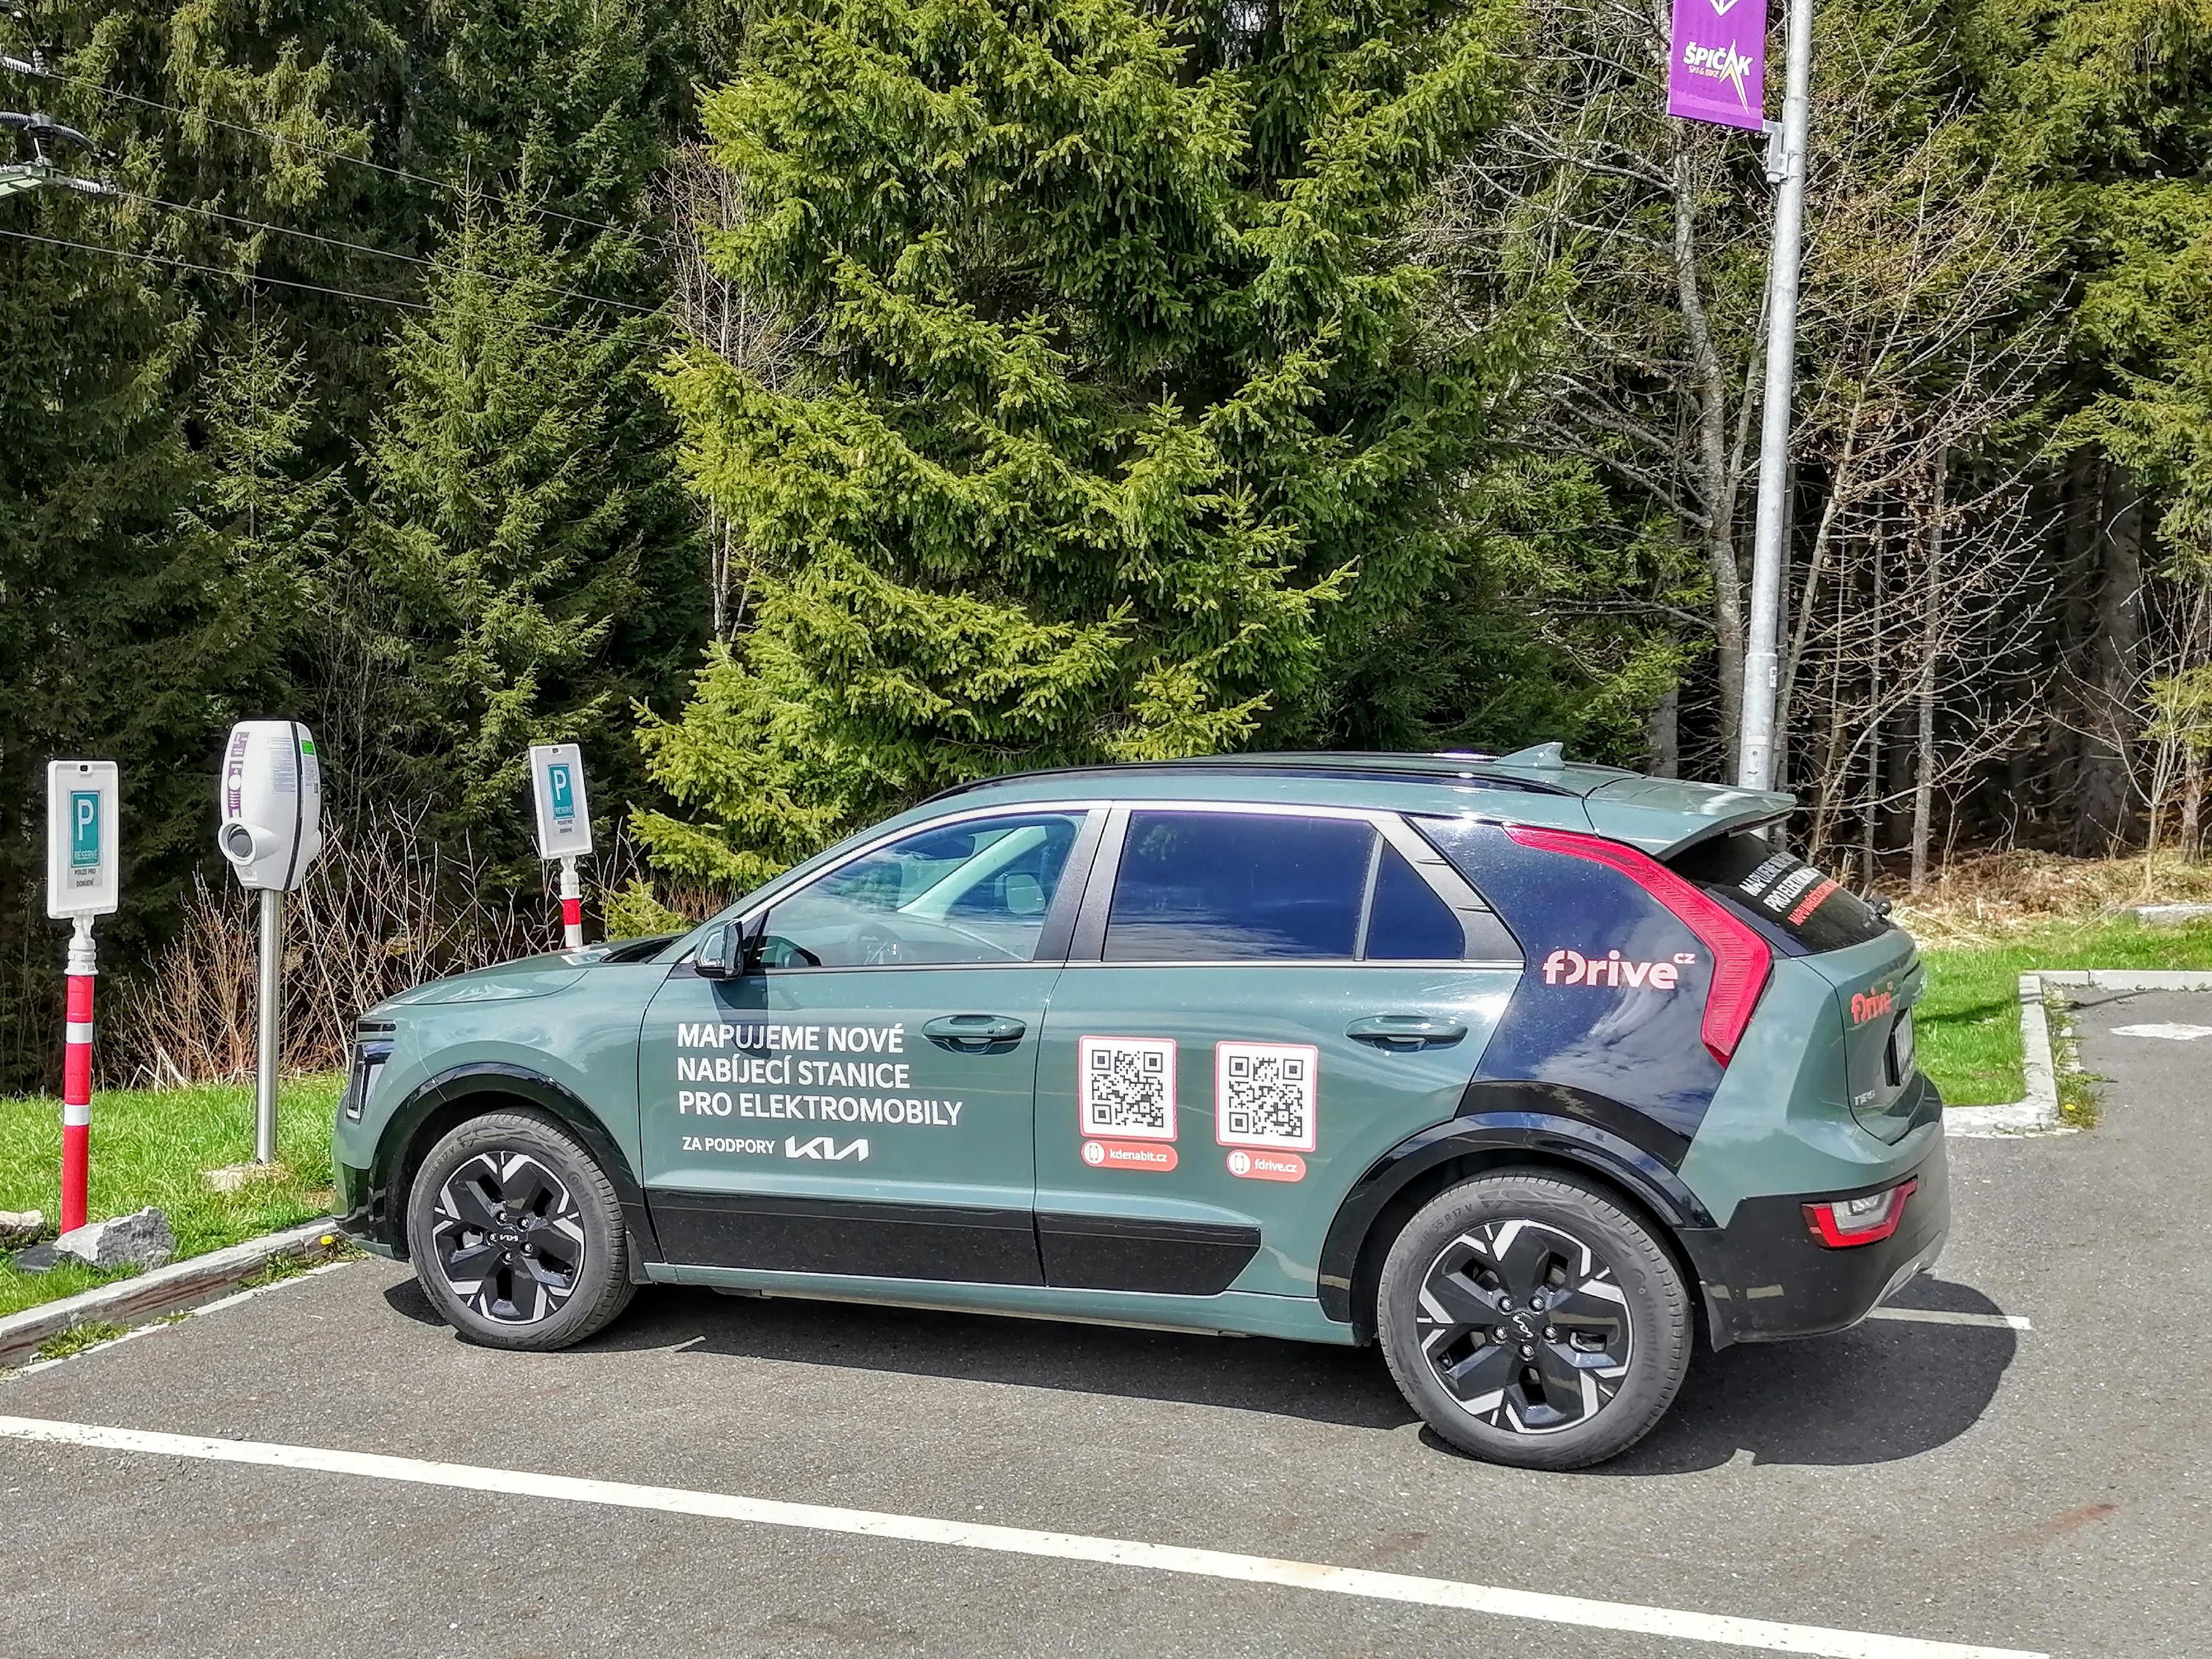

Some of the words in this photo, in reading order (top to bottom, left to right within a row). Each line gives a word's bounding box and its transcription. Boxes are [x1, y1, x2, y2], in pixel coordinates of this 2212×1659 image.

[553, 770, 567, 801] P
[77, 799, 94, 841] P
[677, 1023, 820, 1051] MAPUJEME
[827, 1022, 905, 1053] NOVÉ
[677, 1053, 792, 1085] NABÍJECÍ
[797, 1060, 911, 1089] STANICE
[679, 1090, 732, 1117] PRO
[739, 1093, 963, 1126] ELEKTROMOBILY
[682, 1136, 703, 1151] ZA
[704, 1137, 776, 1154] PODPORY
[784, 1135, 870, 1162] KIA
[1109, 1148, 1168, 1163] kdenabit.cz
[1254, 1158, 1298, 1173] fdrive.cz
